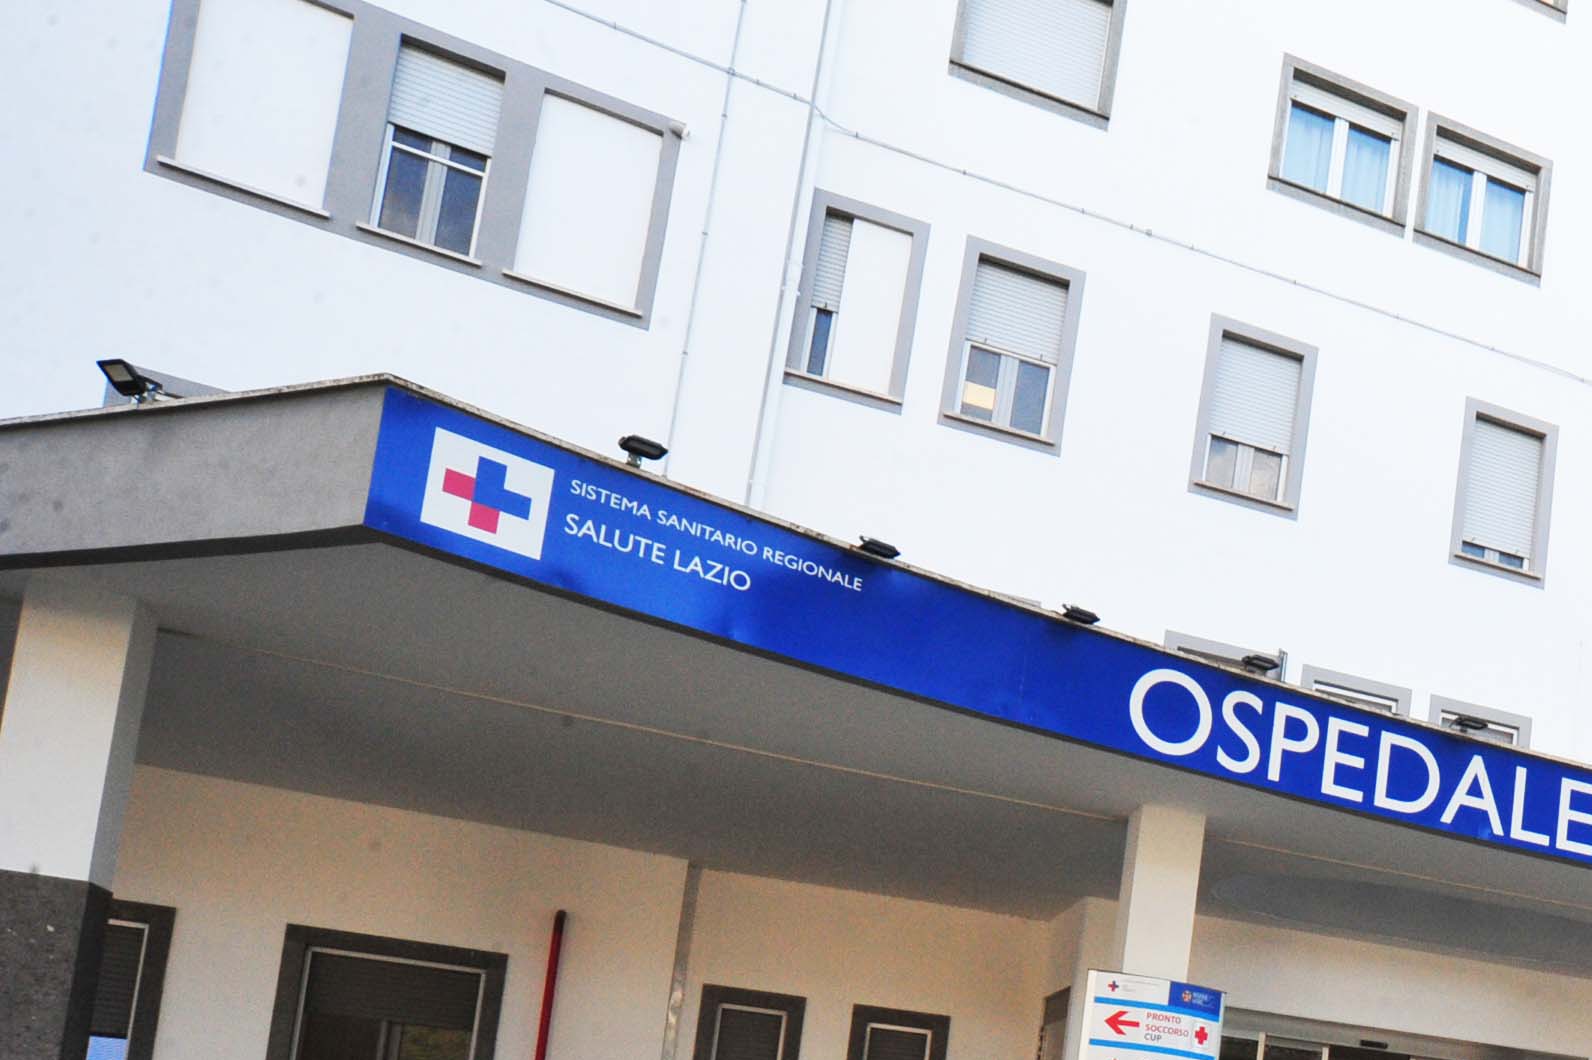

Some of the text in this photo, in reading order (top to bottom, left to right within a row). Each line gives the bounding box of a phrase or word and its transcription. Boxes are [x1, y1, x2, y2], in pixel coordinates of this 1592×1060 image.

[570, 479, 863, 591] SISTEMA SANITARIO REGIONALE
[564, 513, 751, 591] SALUTE LAZIO
[1146, 1011, 1182, 1024] PRONTO
[1143, 1032, 1163, 1042] CUP
[1144, 1023, 1190, 1037] SOCCORSO
